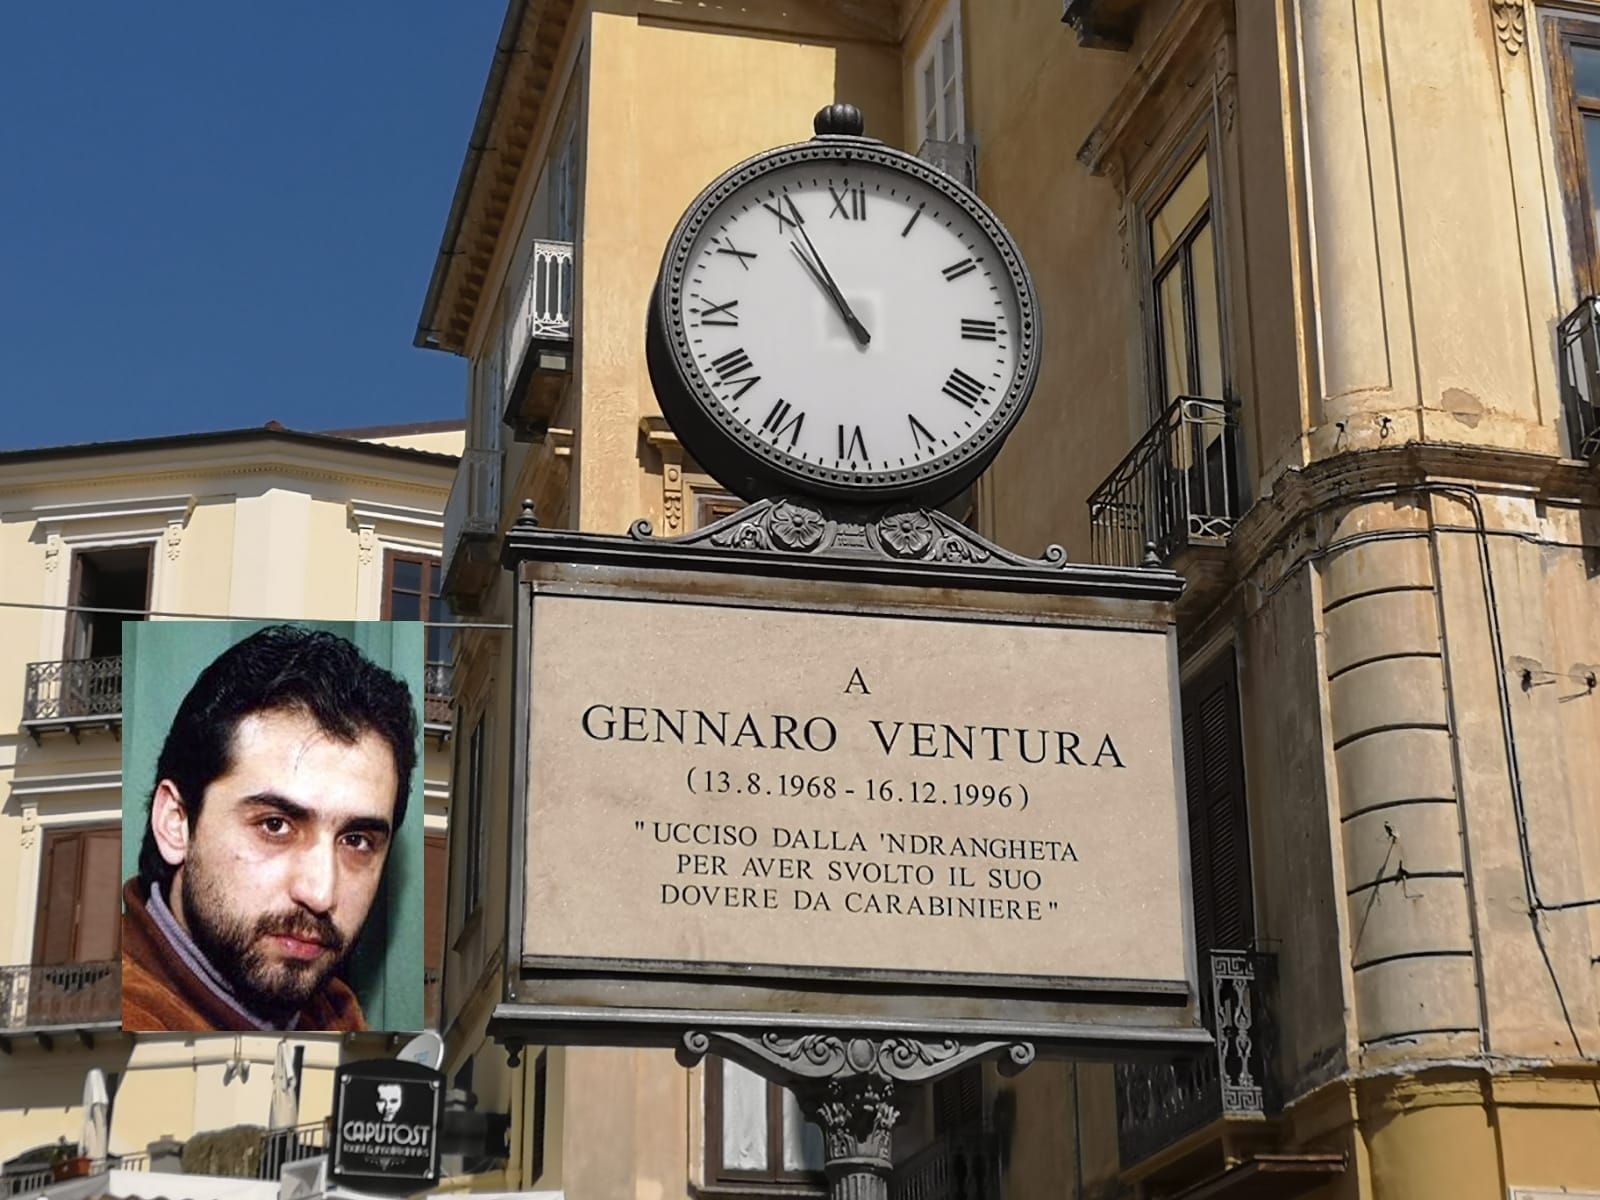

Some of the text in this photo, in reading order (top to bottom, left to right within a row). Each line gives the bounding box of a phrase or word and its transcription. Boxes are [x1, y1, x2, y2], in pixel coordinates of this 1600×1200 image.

[843, 666, 872, 695] A
[581, 703, 1127, 769] GENNARO VENTURA
[772, 827, 868, 852] DALLA
[879, 832, 1079, 863] 'NDRANGHETA
[676, 853, 1042, 891] PER AVER SVOLTO IL SUO
[661, 883, 1058, 921] DOVERE DA CARABINIERE"
[343, 1120, 430, 1146] CAPUTOST
